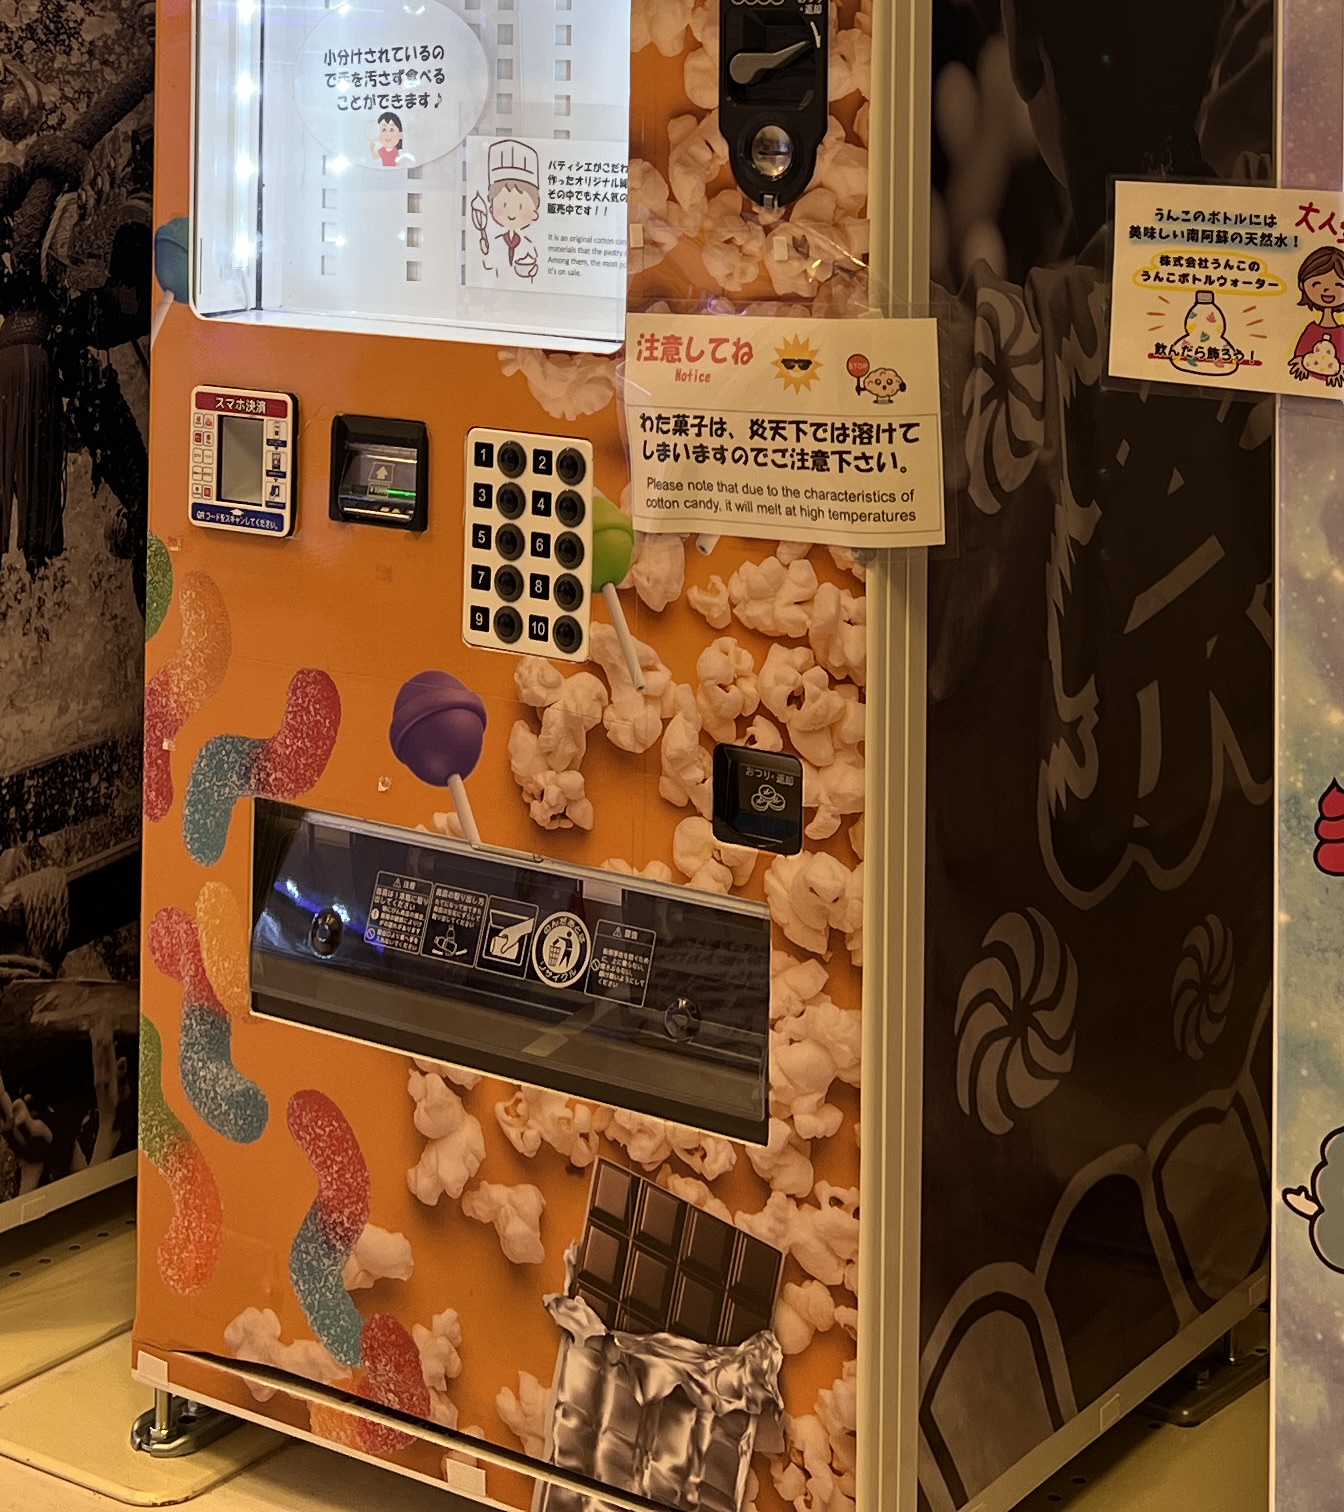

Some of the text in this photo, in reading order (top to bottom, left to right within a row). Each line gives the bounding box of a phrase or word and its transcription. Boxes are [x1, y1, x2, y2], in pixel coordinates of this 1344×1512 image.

[323, 45, 445, 67] 小分けされているの
[1155, 207, 1278, 228] うんこのボトルには
[1159, 255, 1261, 272] 株式会社うんこの
[1140, 270, 1279, 290] うんこボトルウォーター
[636, 333, 753, 365] 注意してね
[675, 368, 711, 383] Notice
[215, 396, 266, 414] スマホ決済
[642, 440, 907, 474] しまいますのでご注意下さい。
[647, 477, 915, 504] Please note that due to the characteristics of
[646, 496, 916, 524] cotton candy, it will melt at high temperatures
